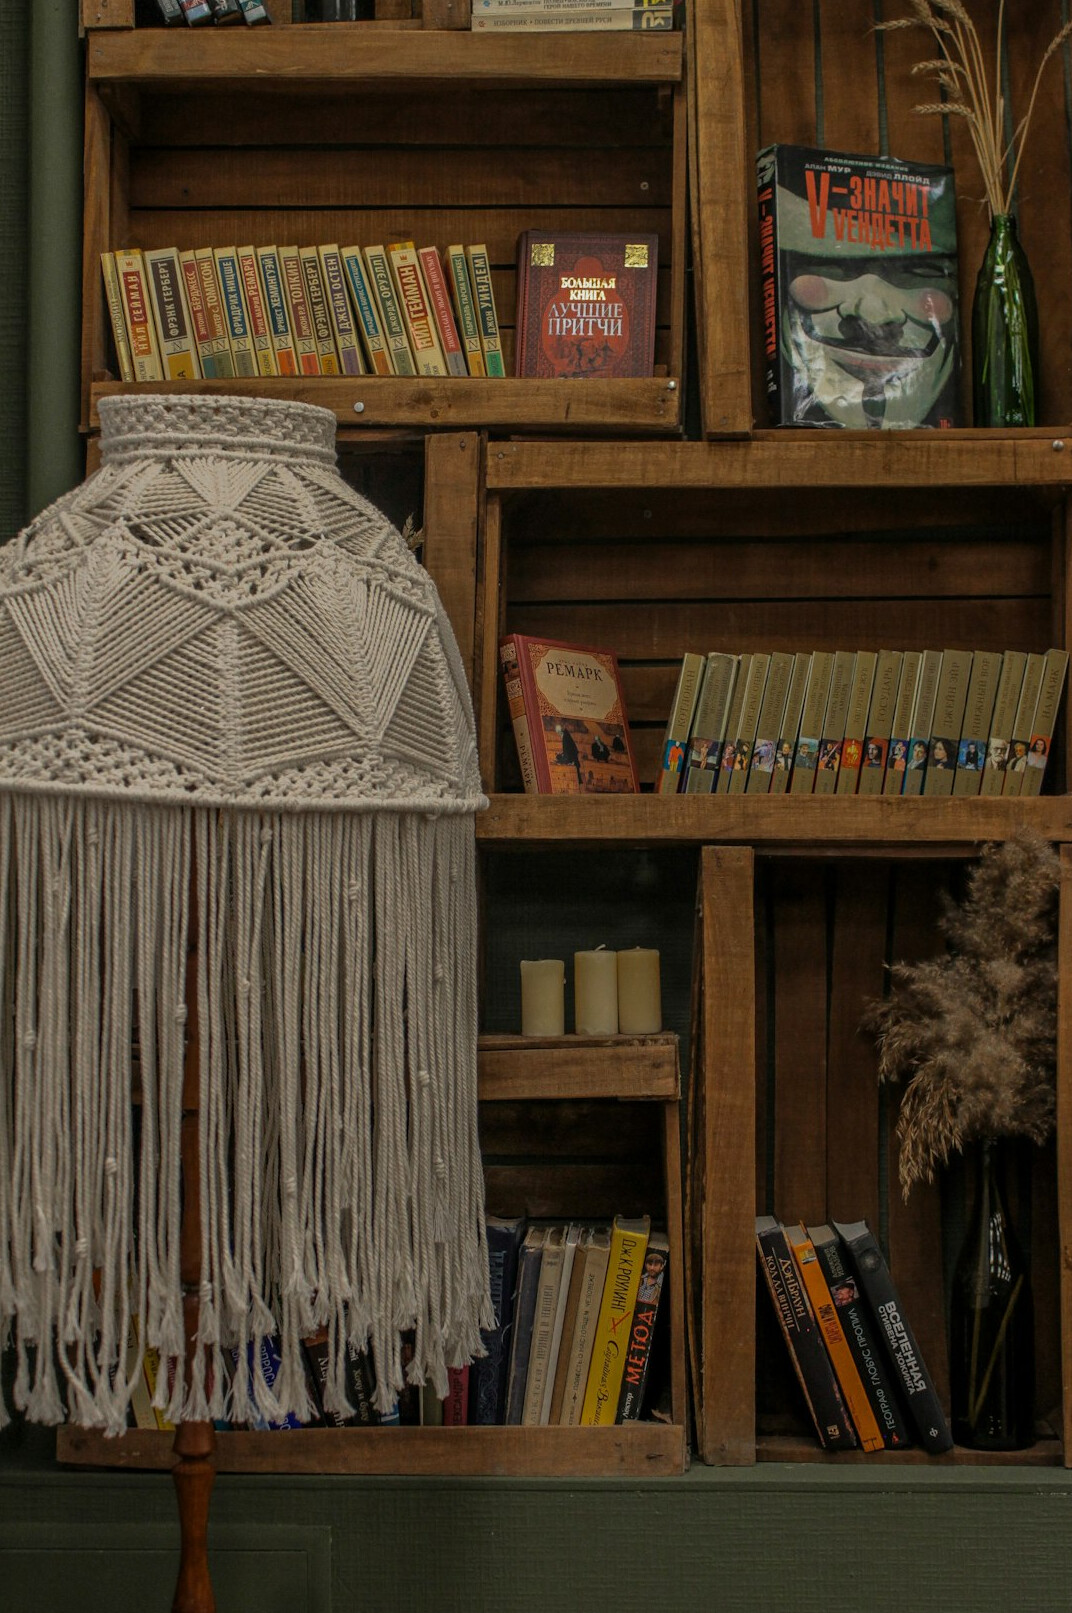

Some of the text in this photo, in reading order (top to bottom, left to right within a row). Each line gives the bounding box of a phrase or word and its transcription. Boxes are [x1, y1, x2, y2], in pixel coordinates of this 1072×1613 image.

[828, 165, 851, 173] МУР
[894, 173, 930, 184] ЛЛОЙД
[157, 261, 180, 336] ФРЭНК ГЕРБЕРТ
[185, 269, 204, 310] БЕРДЖЕСС
[199, 260, 218, 307] ТОМПСОН
[222, 260, 245, 334] ФРИДРИХ НИЦШЕ
[241, 258, 266, 333] ЭРИХ МАРИЯ РЕМАРК
[261, 257, 285, 332] ЭРНЕСТ ХЕМИНГУЭЙ
[285, 260, 304, 304] ТОЛКИН
[304, 260, 329, 337] ФРЭНК ГЕРБЕРТ
[326, 257, 351, 330] ДЖЕЙН ОСТЕН
[372, 258, 401, 332] ДЖОРДЖ ОРУЭЛЛ
[397, 265, 426, 318] ГЕЙМАН
[473, 257, 496, 333] ДЖОН УИНДЕМ
[561, 277, 616, 289] БОЛЬШАЯ
[569, 290, 606, 300] КНИГА
[125, 274, 148, 349] НИЛ ГЕЙМАН
[211, 312, 224, 336] ХАНТЕР
[298, 314, 310, 335] ДЖОН
[548, 303, 623, 317] ЛУЧШИЕ
[548, 318, 622, 336] ПРИТЧИ
[409, 319, 433, 347] НИЛ
[546, 662, 603, 682] РЕМАРК
[876, 666, 893, 722] ГОСУДАРЬ
[1041, 668, 1060, 719] НА МАЯК
[676, 669, 695, 728] КОТЛОВАН
[941, 686, 958, 728] ДЖЕЙН
[518, 743, 532, 786] РЕМАРК
[584, 1272, 596, 1307] ЧЕЛОВЕКЕ
[577, 1310, 590, 1352] НАСТОЯЩЕМ
[623, 1309, 654, 1386] МЕТОД
[875, 1304, 918, 1395] СТИВЕНА ХОКИНГА
[882, 1300, 928, 1392] ВСЕЛЕННАЯ
[572, 1358, 583, 1390] ПОВЕСТЬ
[845, 1307, 897, 1429] ГЕОГРАФ ГЛОБУС ПРОПИЛ
[621, 1391, 634, 1419] Лектор
